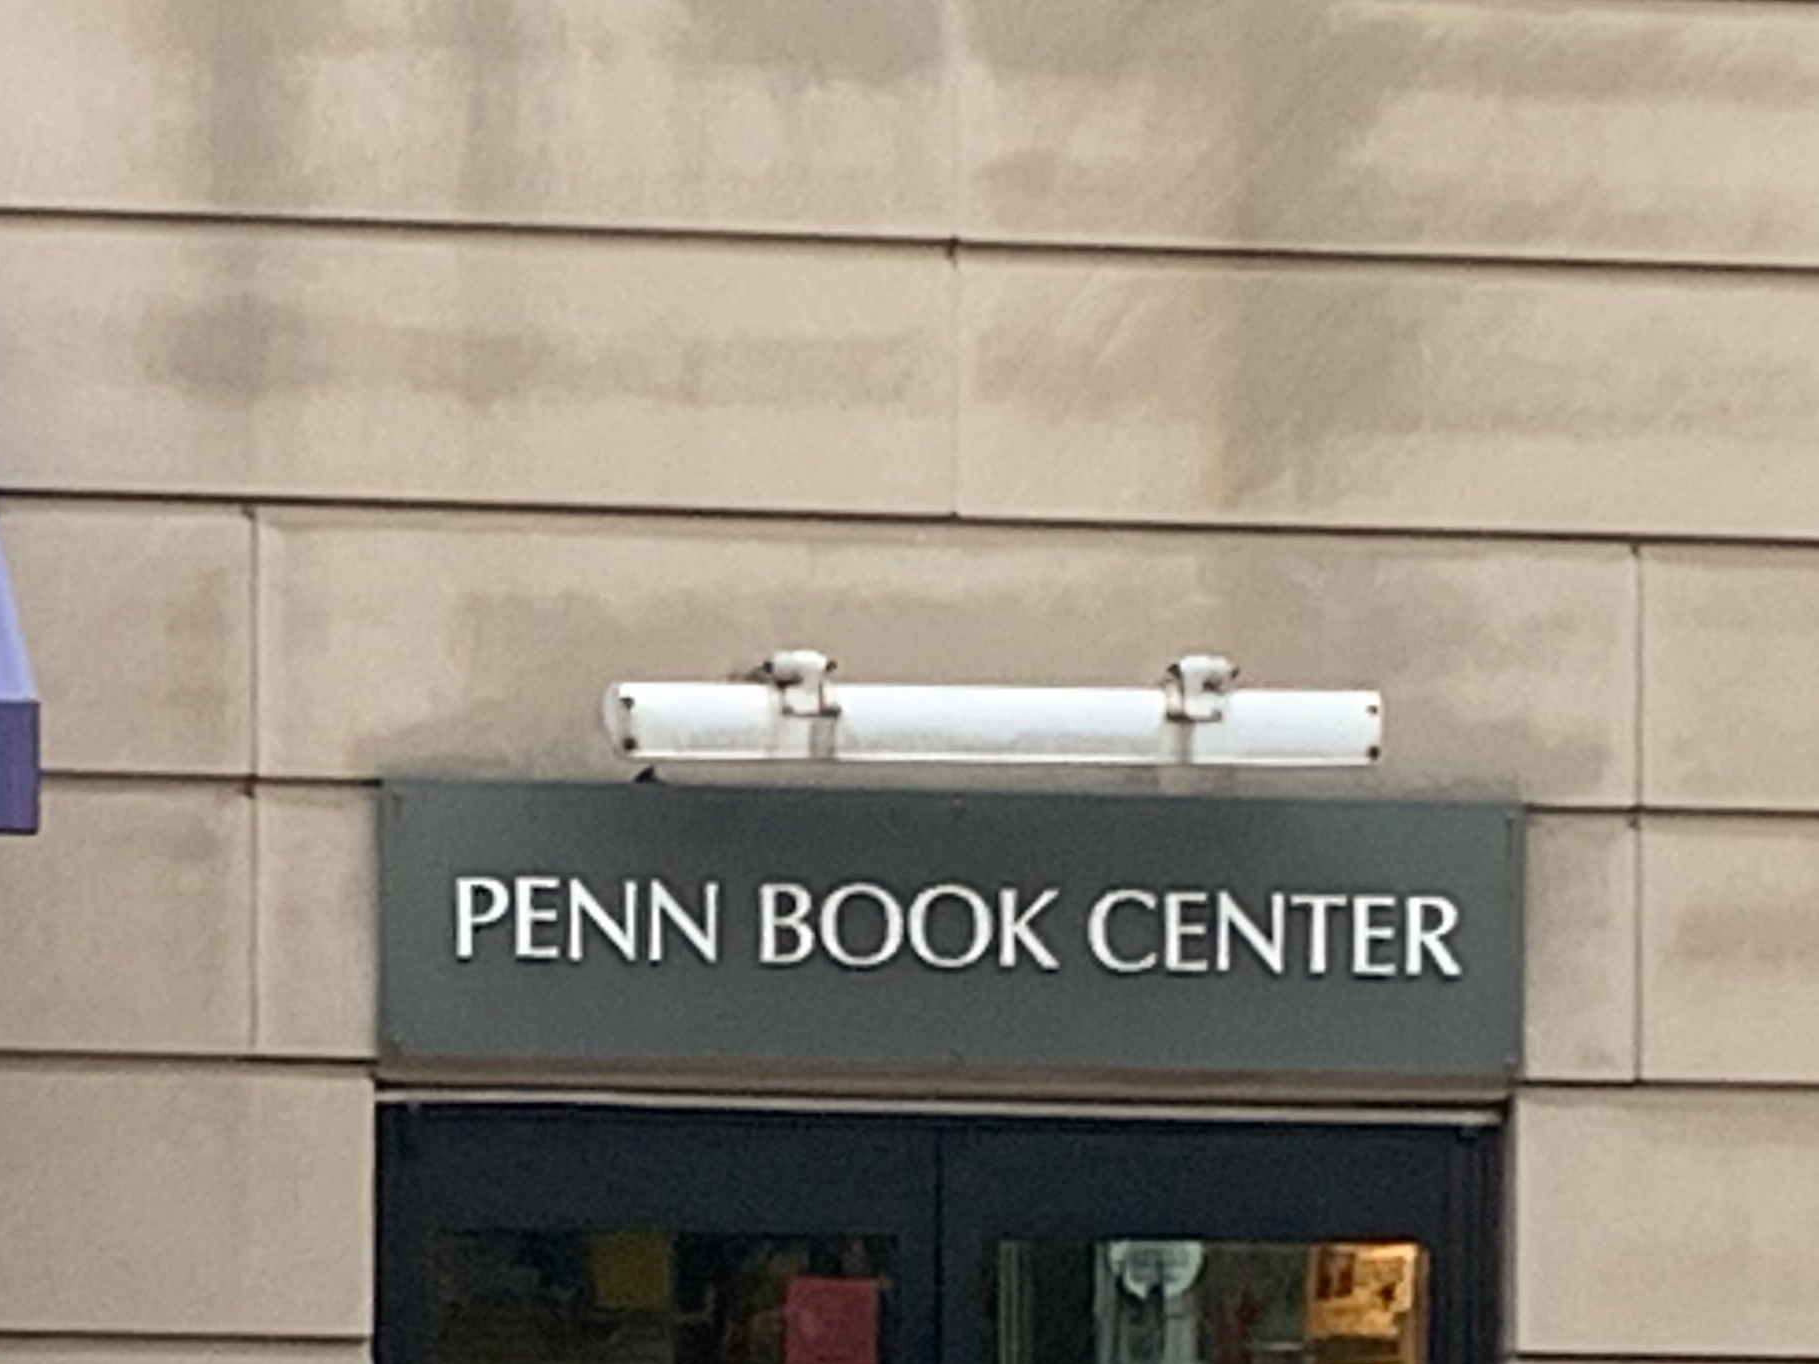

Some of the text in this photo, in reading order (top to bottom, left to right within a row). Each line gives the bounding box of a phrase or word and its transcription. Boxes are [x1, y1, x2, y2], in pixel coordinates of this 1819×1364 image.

[454, 874, 1463, 977] PENN BOOK CENTER
